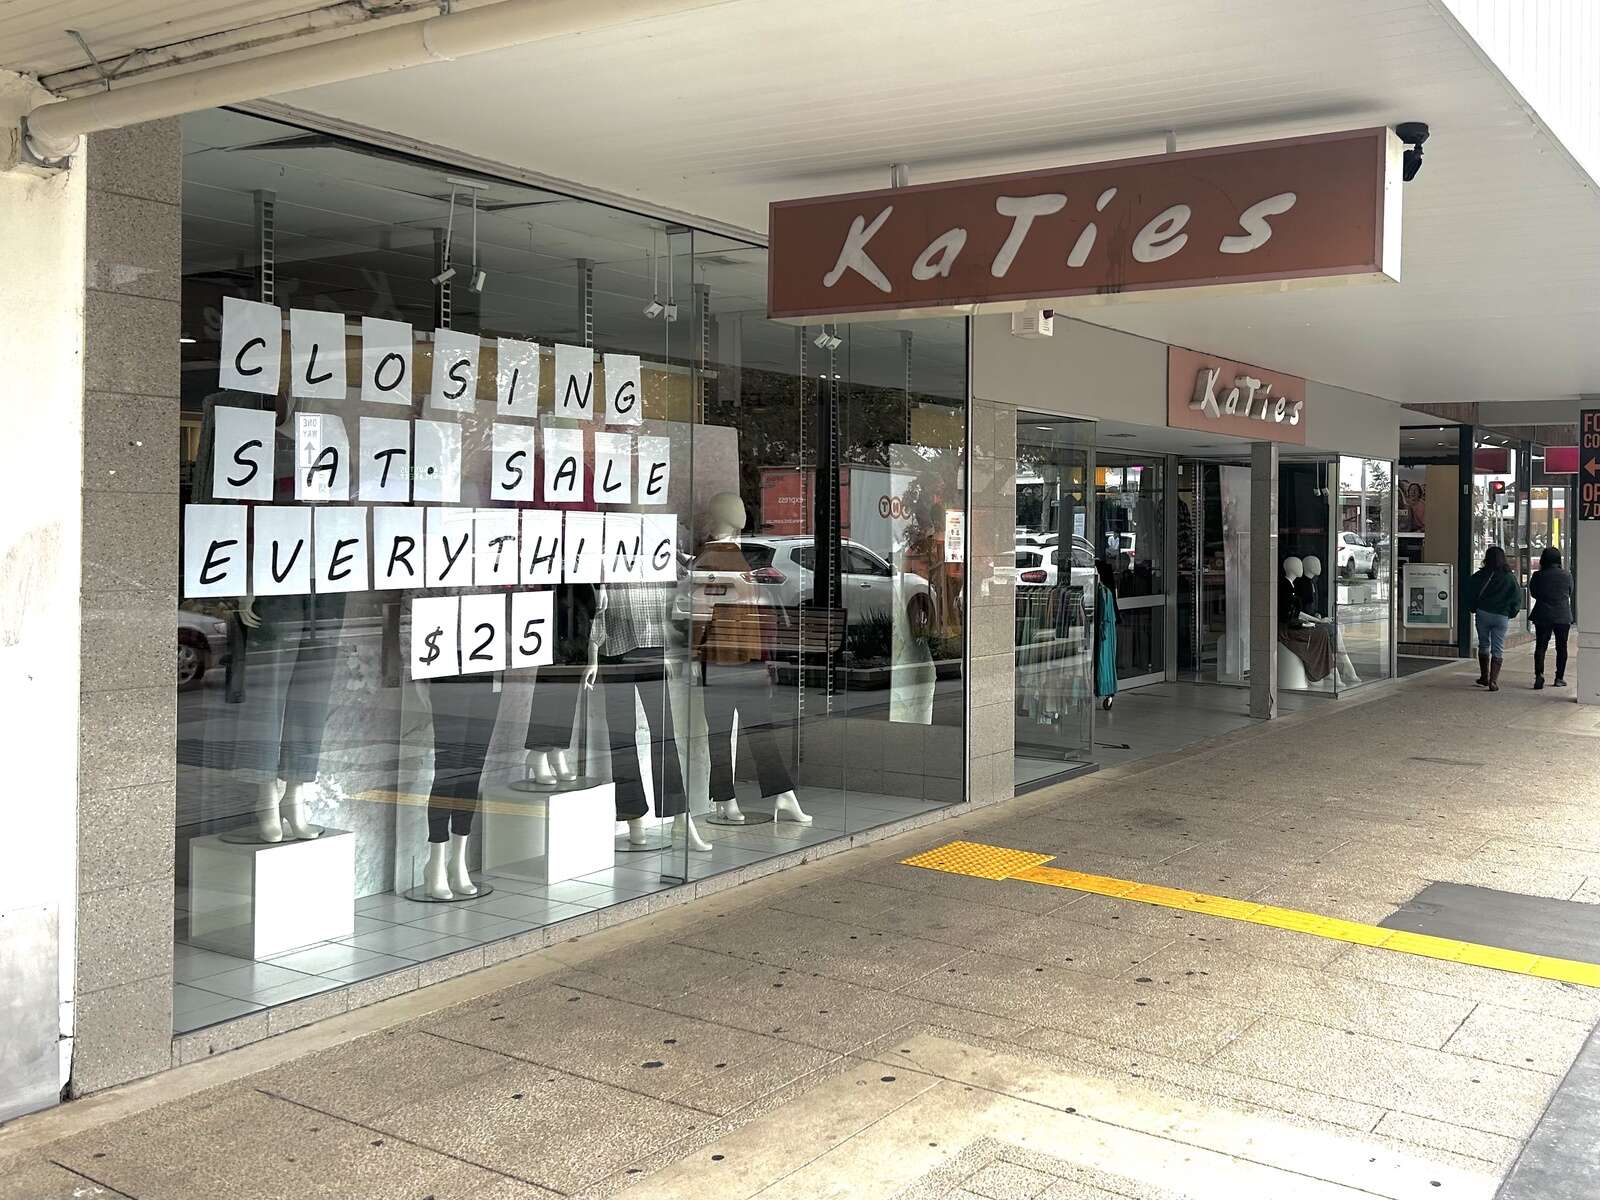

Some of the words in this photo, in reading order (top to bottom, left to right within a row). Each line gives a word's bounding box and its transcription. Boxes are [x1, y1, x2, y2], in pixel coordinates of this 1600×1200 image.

[235, 338, 634, 414] CLOSING
[501, 450, 666, 495] SALE
[1584, 503, 1591, 517] 7
[201, 532, 672, 584] EVERYTHING
[419, 617, 545, 666] $25
